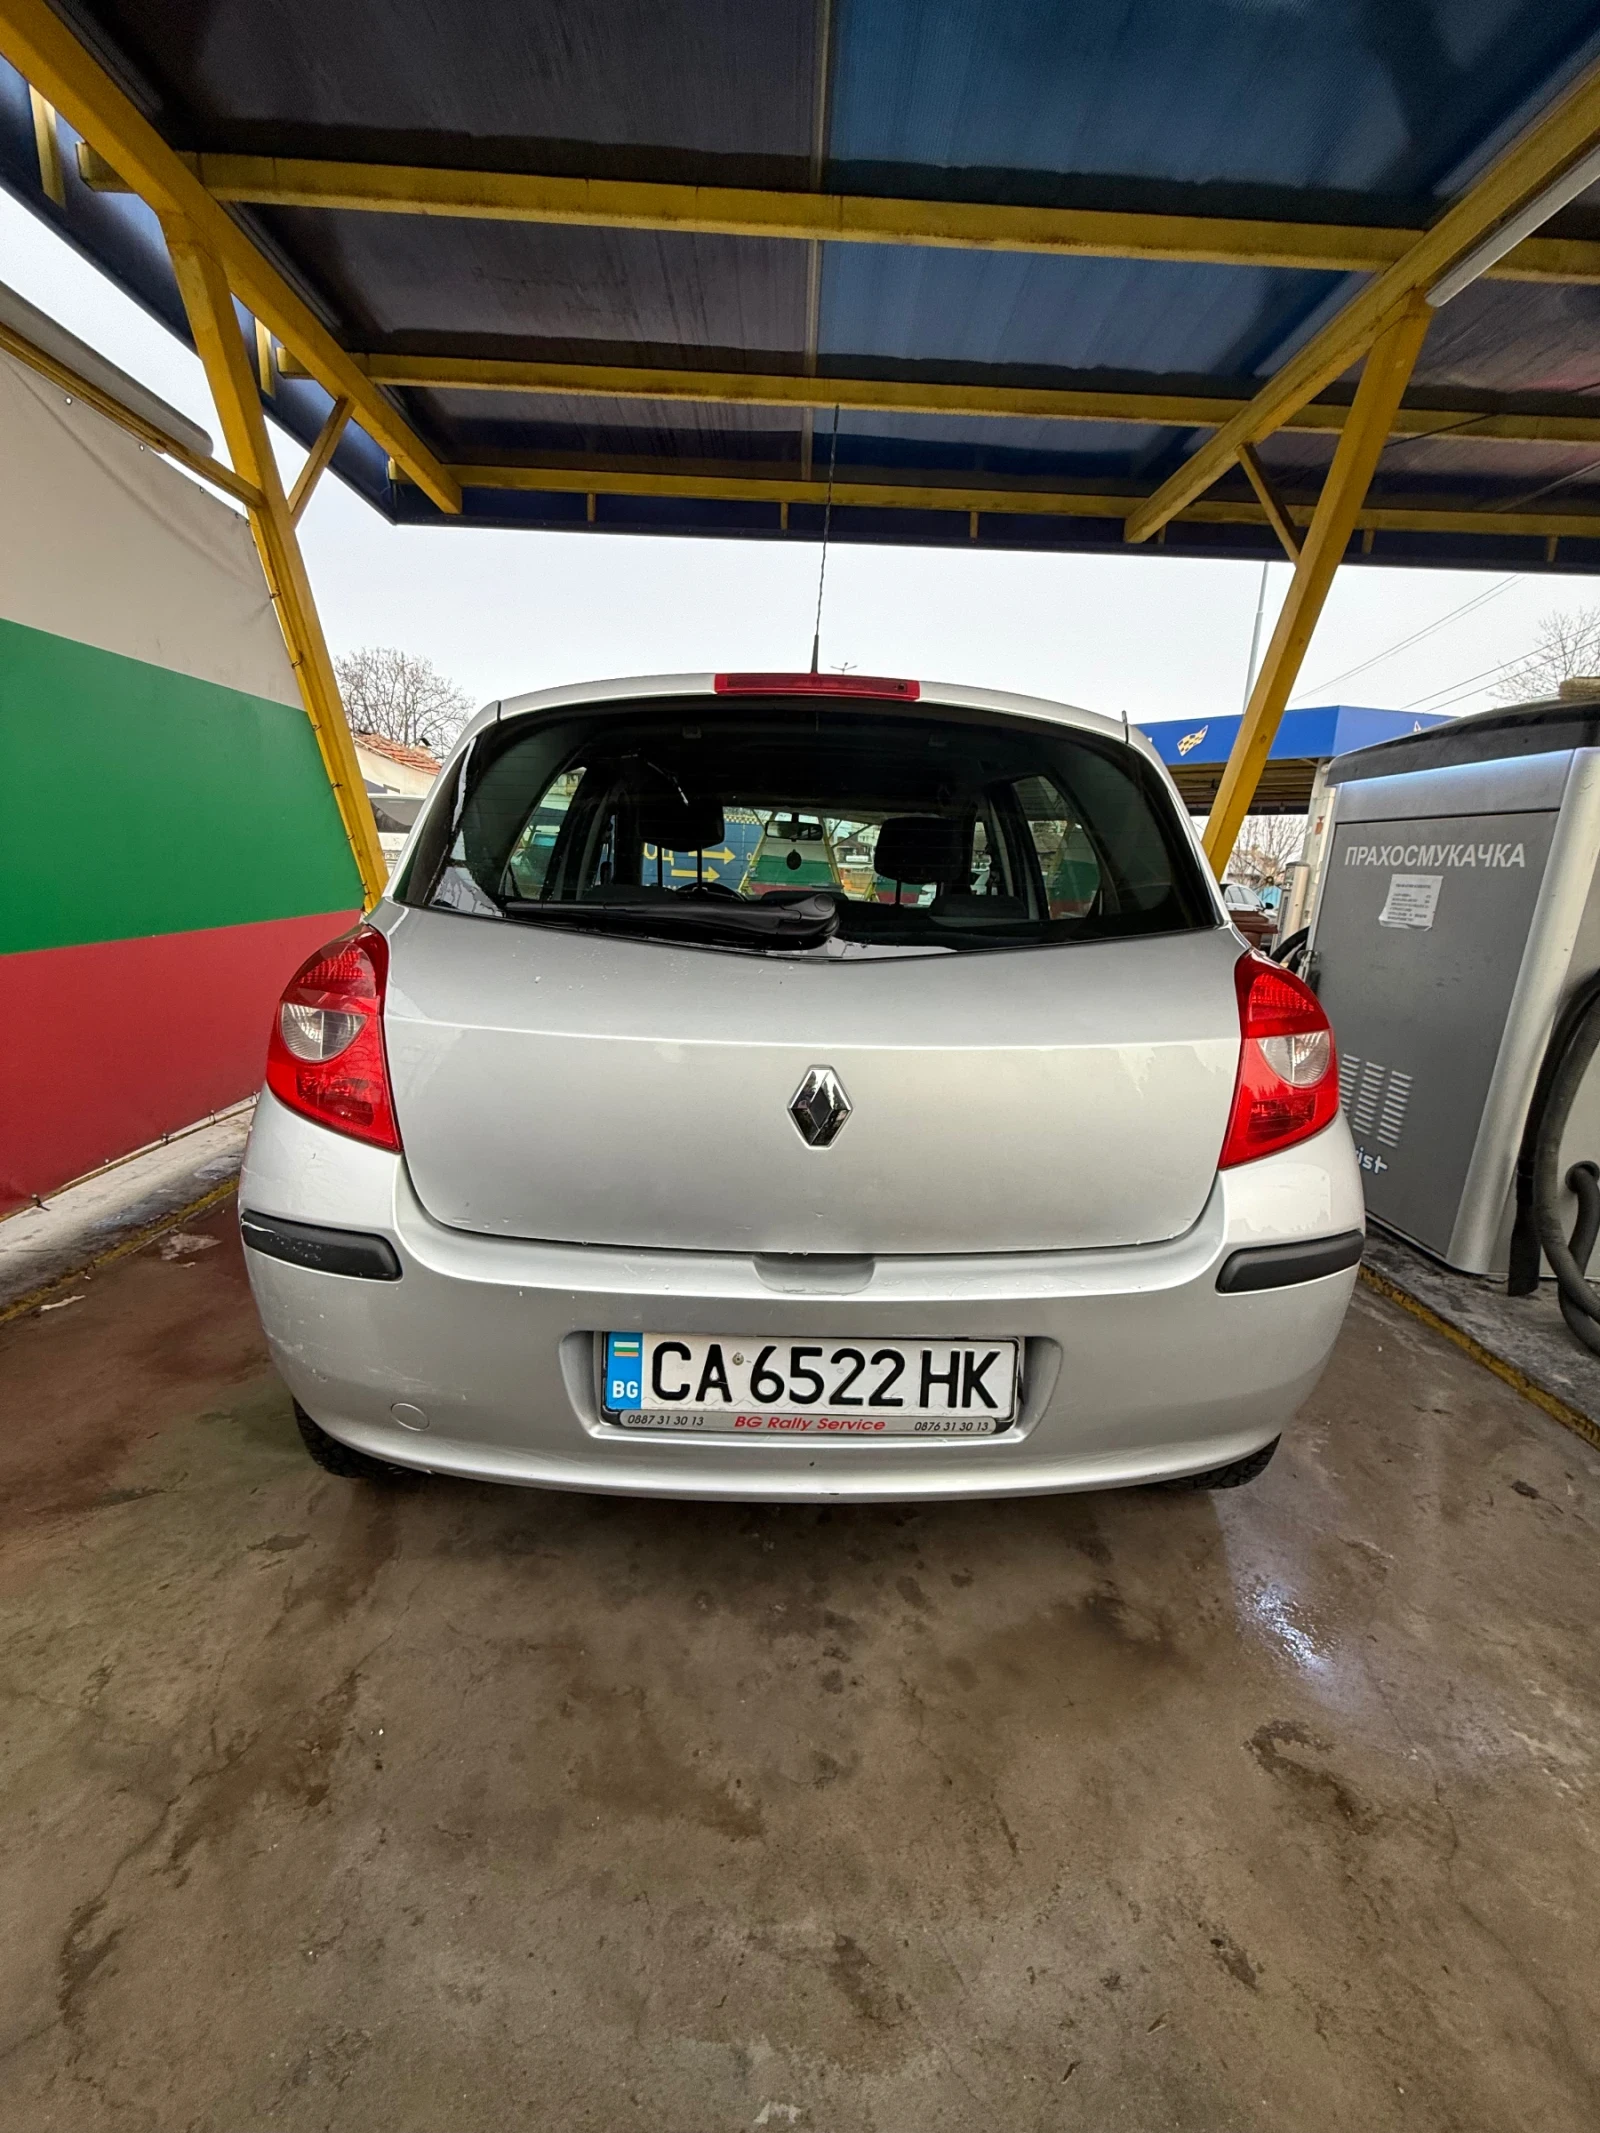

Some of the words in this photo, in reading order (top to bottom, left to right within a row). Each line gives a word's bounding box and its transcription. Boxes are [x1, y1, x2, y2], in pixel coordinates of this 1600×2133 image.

[1344, 842, 1526, 868] ПРАХОСМУКАЧКА
[1355, 1146, 1388, 1174] ist
[652, 1341, 733, 1403] CA
[750, 1345, 905, 1407] 6522
[919, 1349, 1001, 1409] HK
[612, 1380, 639, 1399] BG
[627, 1414, 655, 1425] 0887
[657, 1415, 671, 1426] 31
[673, 1415, 689, 1426] 30
[692, 1416, 704, 1426] 13
[734, 1416, 763, 1428] BG
[767, 1416, 813, 1432] Rally
[817, 1418, 886, 1431] Service
[914, 1421, 941, 1432] 0876
[943, 1421, 957, 1432] 31
[959, 1422, 974, 1432] 30
[977, 1422, 989, 1432] 13
